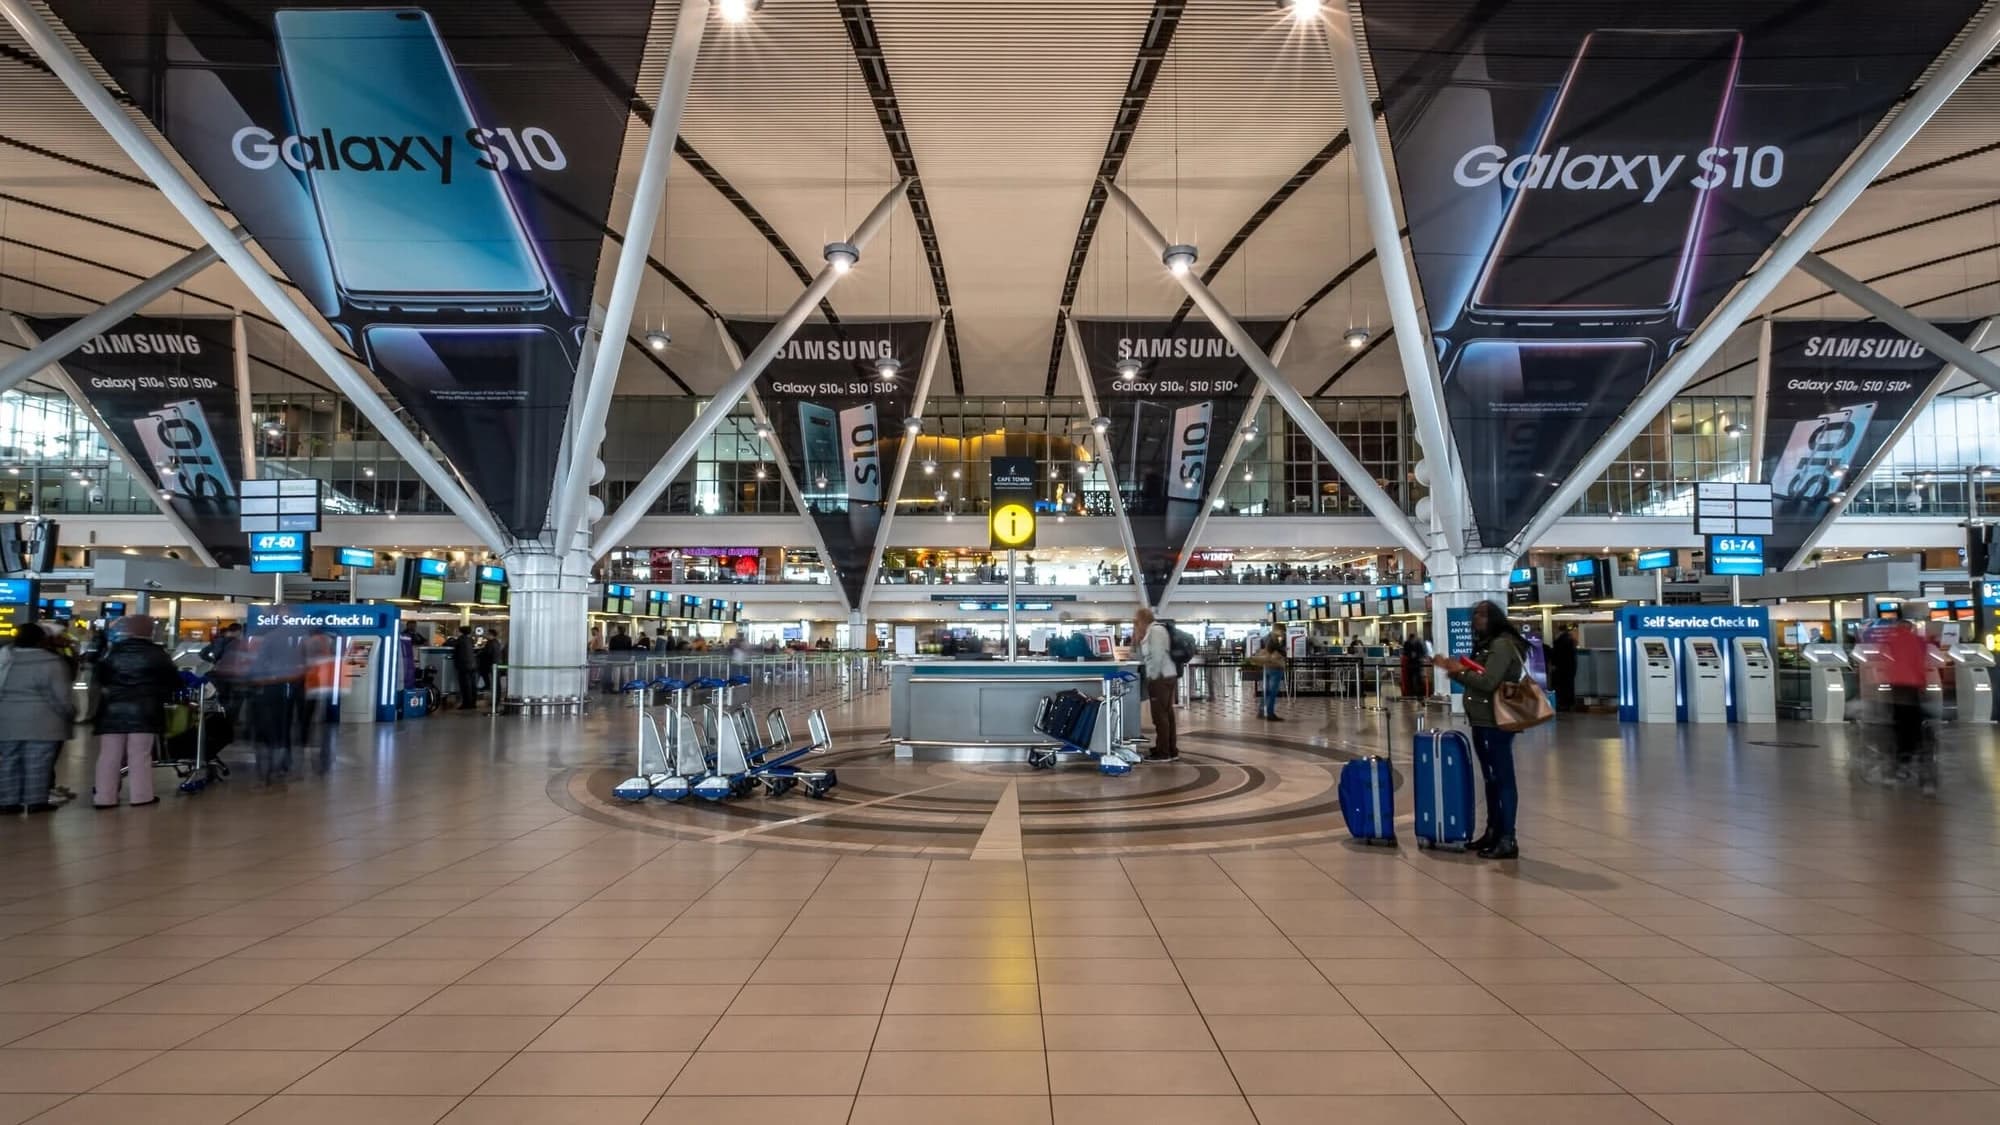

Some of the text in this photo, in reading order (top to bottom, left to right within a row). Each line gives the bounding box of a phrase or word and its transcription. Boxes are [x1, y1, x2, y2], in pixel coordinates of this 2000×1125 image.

[232, 125, 567, 184] Galaxy S10
[1453, 144, 1783, 203] Galaxy S10
[91, 377, 219, 391] Galaxy S10e S10 S10+
[772, 382, 899, 396] Galaxy S10e S10 S10+
[1112, 380, 1239, 395] Galaxy S10e S10 S10+
[1787, 379, 1833, 394] Galaxy
[1862, 380, 1883, 391] S10
[1886, 381, 1912, 392] S10+
[157, 418, 226, 499] S10
[851, 423, 880, 486] S10
[1179, 421, 1208, 485] S10
[1787, 421, 1856, 500] S10
[1720, 539, 1756, 551] 61-74
[1201, 552, 1234, 561] WIMPY
[257, 614, 374, 626] Self Service Check In
[1643, 616, 1759, 628] Self Service Check In
